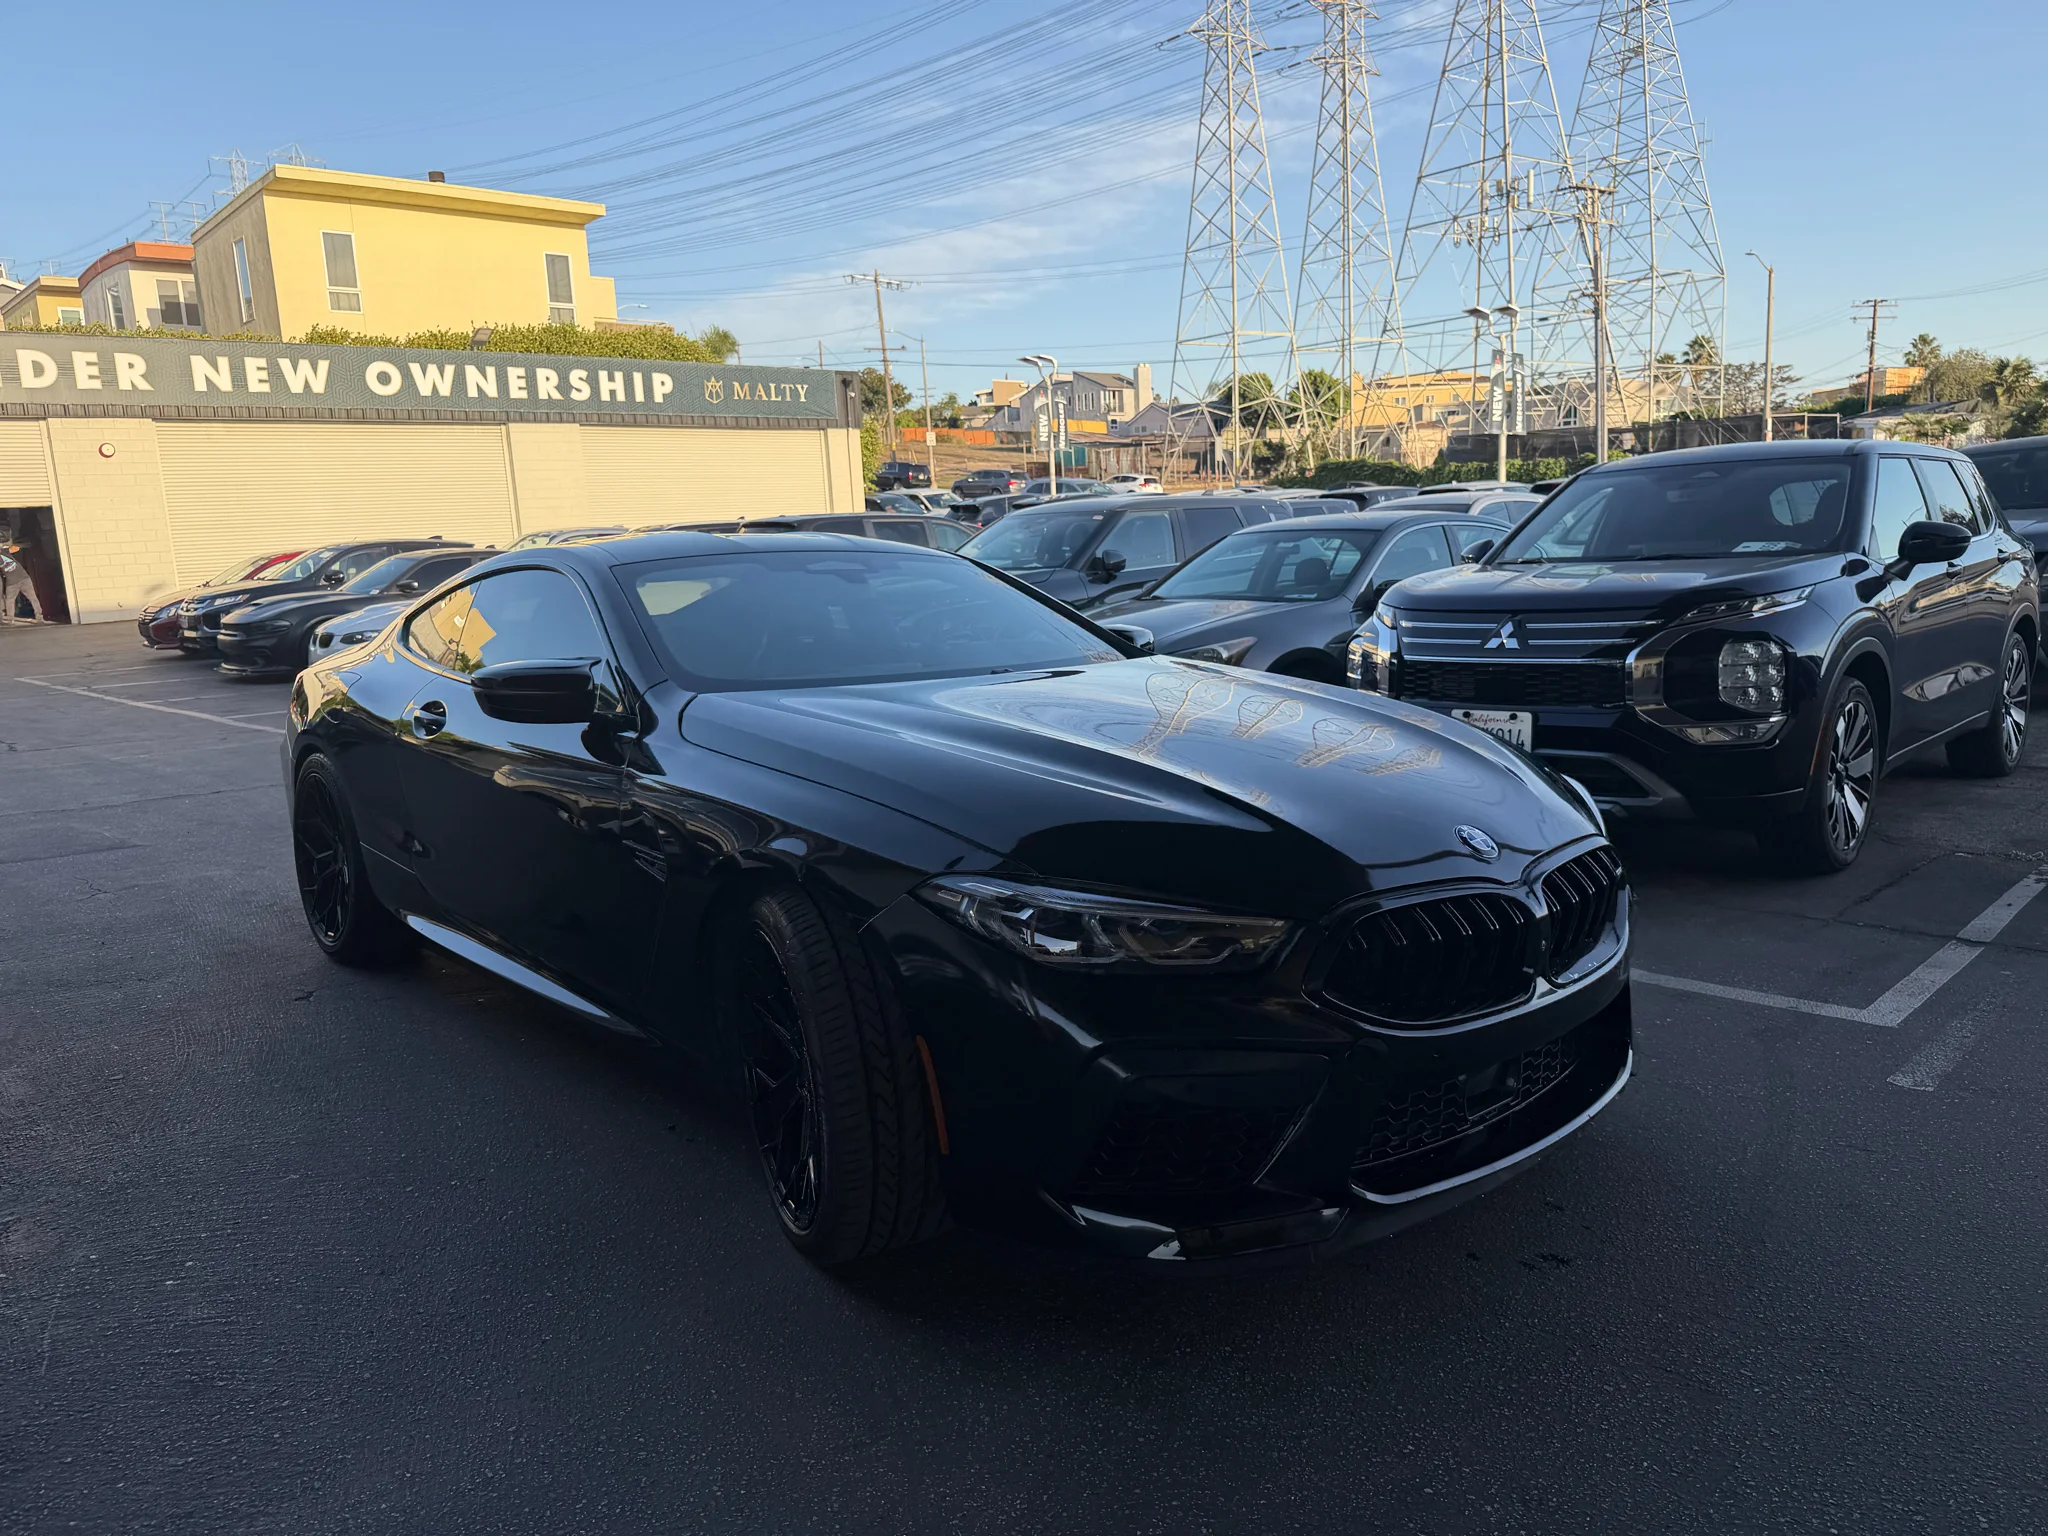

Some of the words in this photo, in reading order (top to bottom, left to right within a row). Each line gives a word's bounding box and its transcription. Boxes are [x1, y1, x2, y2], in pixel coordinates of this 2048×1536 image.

[0, 348, 155, 391] DER
[189, 354, 330, 394] NEW
[365, 360, 674, 403] OWNERSHIP
[732, 381, 809, 402] MALTY
[1492, 386, 1503, 422] NEW
[1038, 414, 1049, 441] NEW
[1058, 403, 1066, 449] VEHICLES
